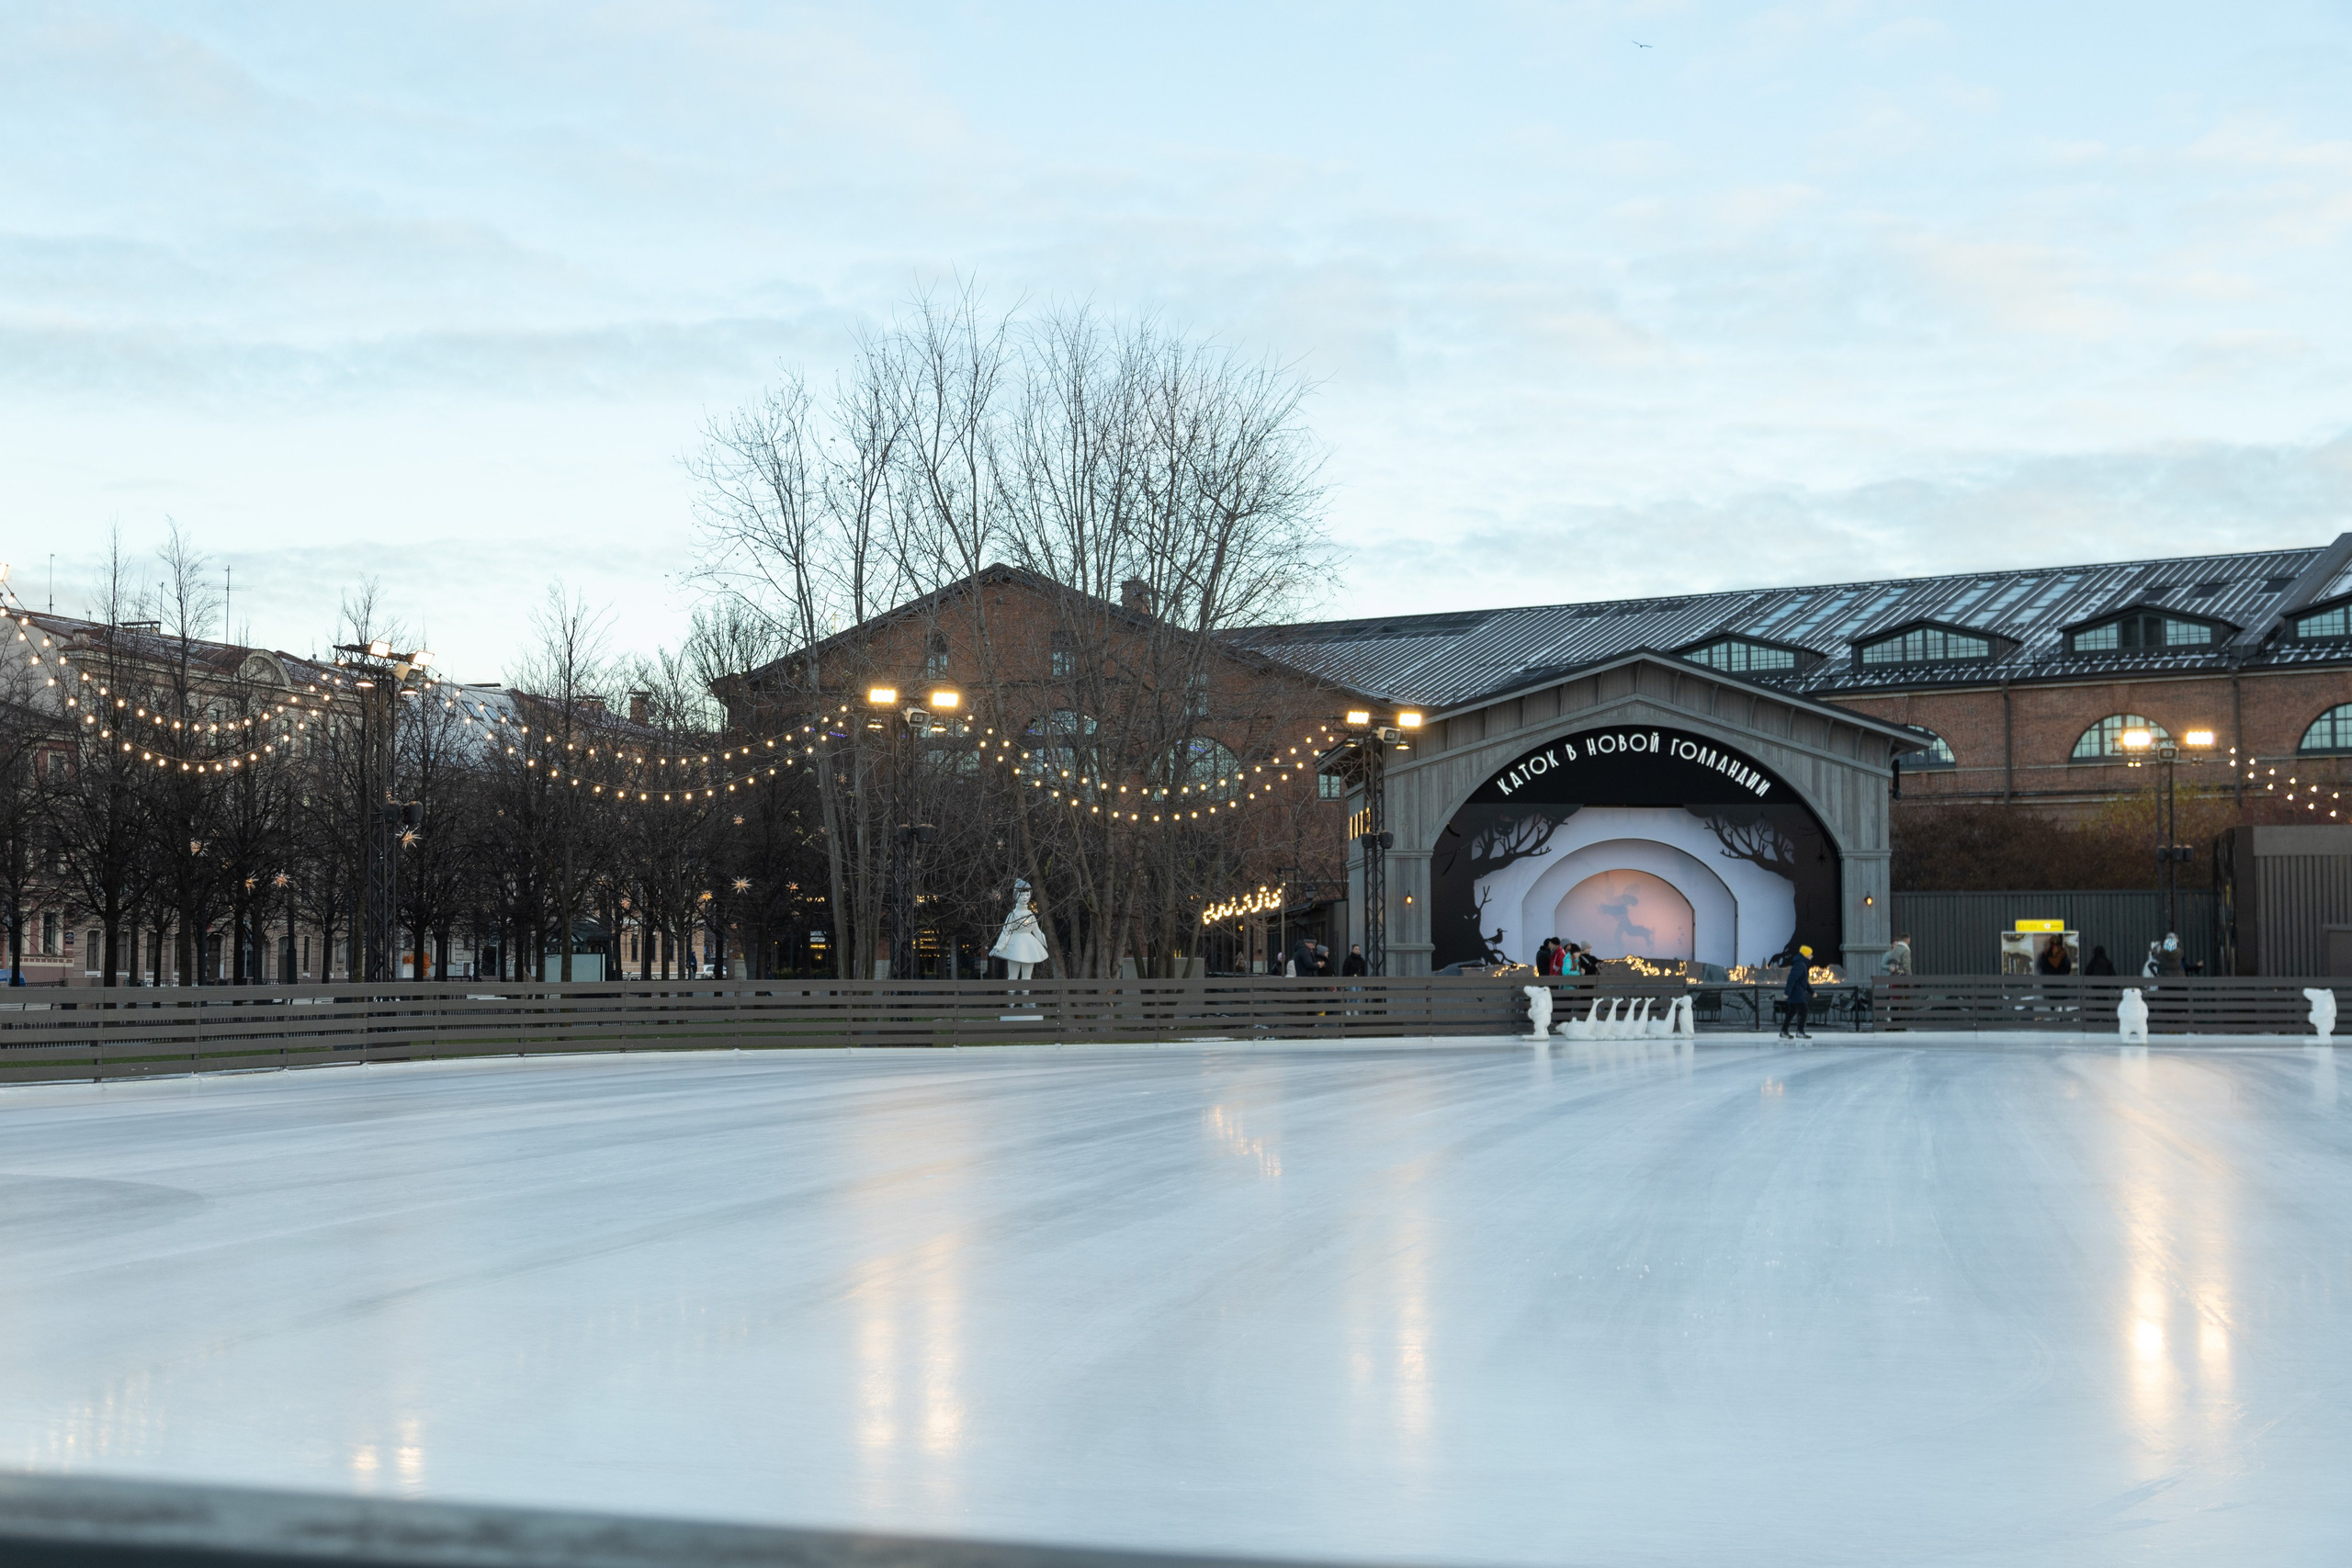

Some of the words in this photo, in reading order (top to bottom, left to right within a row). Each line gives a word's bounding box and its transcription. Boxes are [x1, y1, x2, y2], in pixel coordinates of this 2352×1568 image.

[1497, 750, 1560, 795] КАТОК
[1565, 743, 1577, 761] В
[1586, 731, 1660, 756] НОВОЙ
[1670, 738, 1771, 797] ГОЛЛАНДИИ
